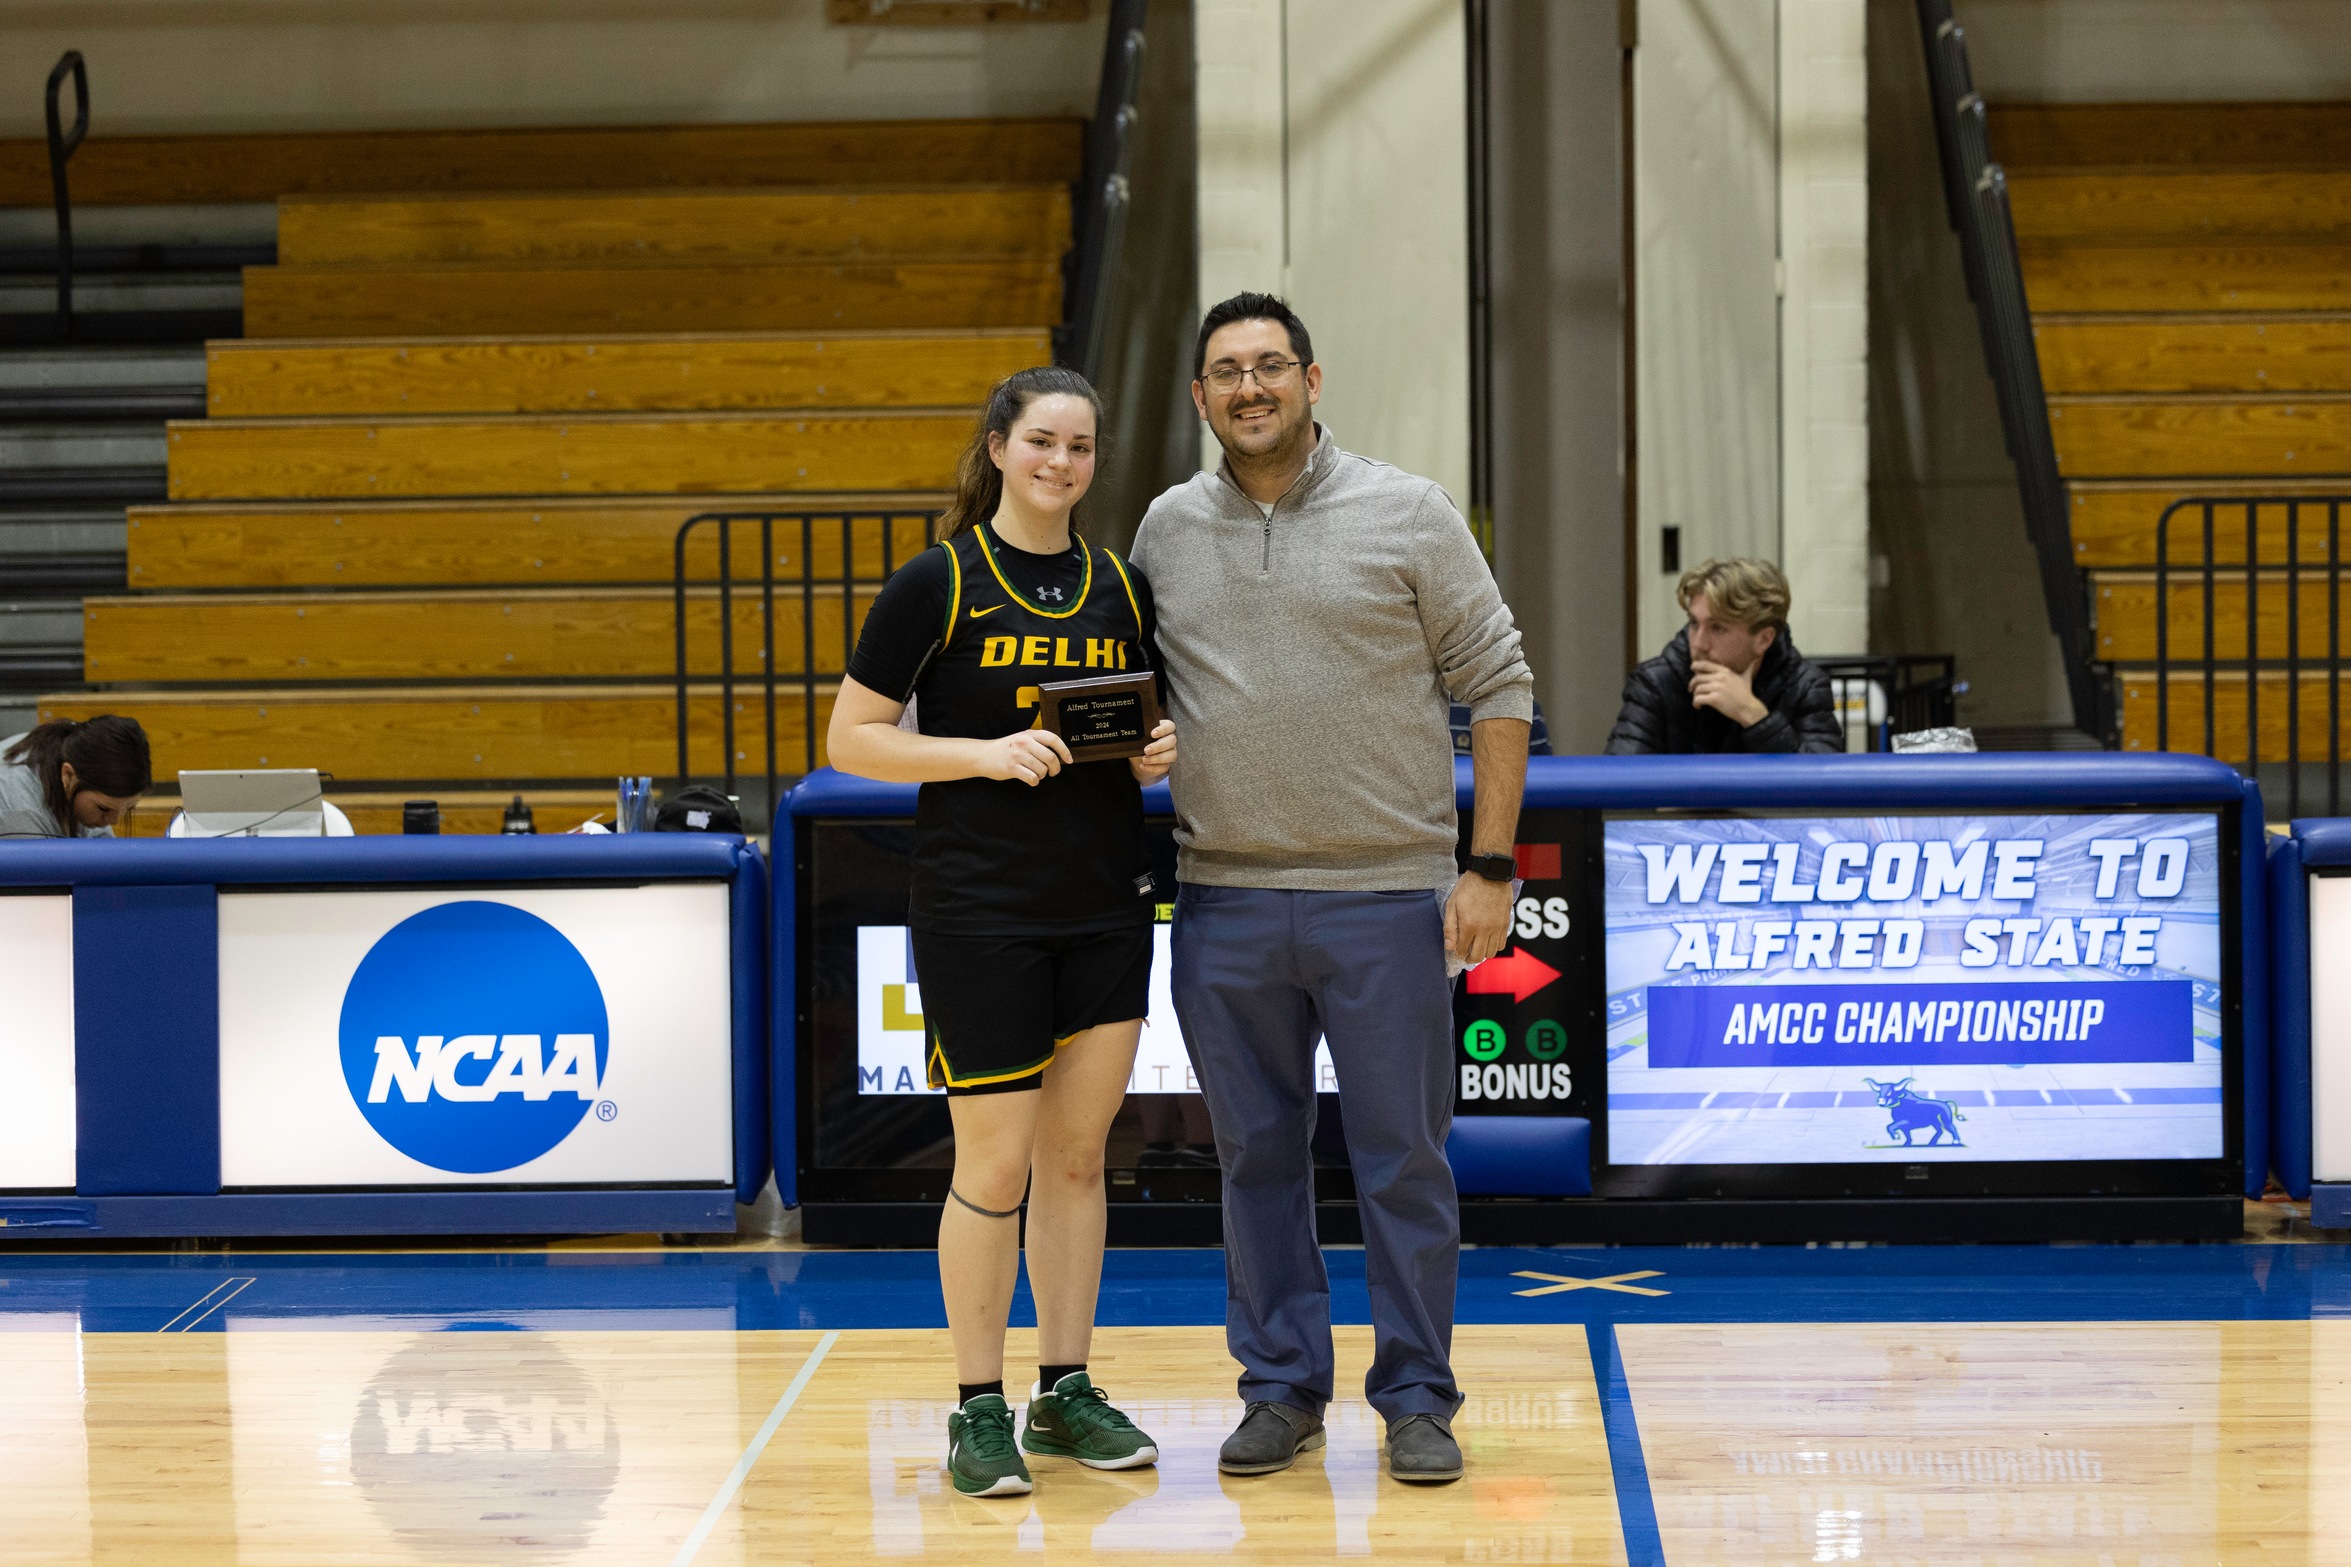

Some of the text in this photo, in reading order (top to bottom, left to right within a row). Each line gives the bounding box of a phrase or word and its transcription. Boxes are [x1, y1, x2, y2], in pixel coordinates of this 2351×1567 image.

[979, 635, 1127, 669] DELHI
[1066, 698, 1135, 713] Alfred Tournament
[1082, 732, 1119, 741] Tournament
[1120, 729, 1137, 737] Team
[1095, 721, 1110, 729] 2024
[1636, 837, 2190, 904] WELCOME TO
[1507, 896, 1571, 940] SS
[1665, 916, 2162, 971] ALFRED STATE
[1476, 1028, 1558, 1052] B B
[1722, 998, 2105, 1045] AMCC CHAMPIONSHIP
[366, 1033, 599, 1103] NCAA
[1460, 1062, 1572, 1100] BONUS
